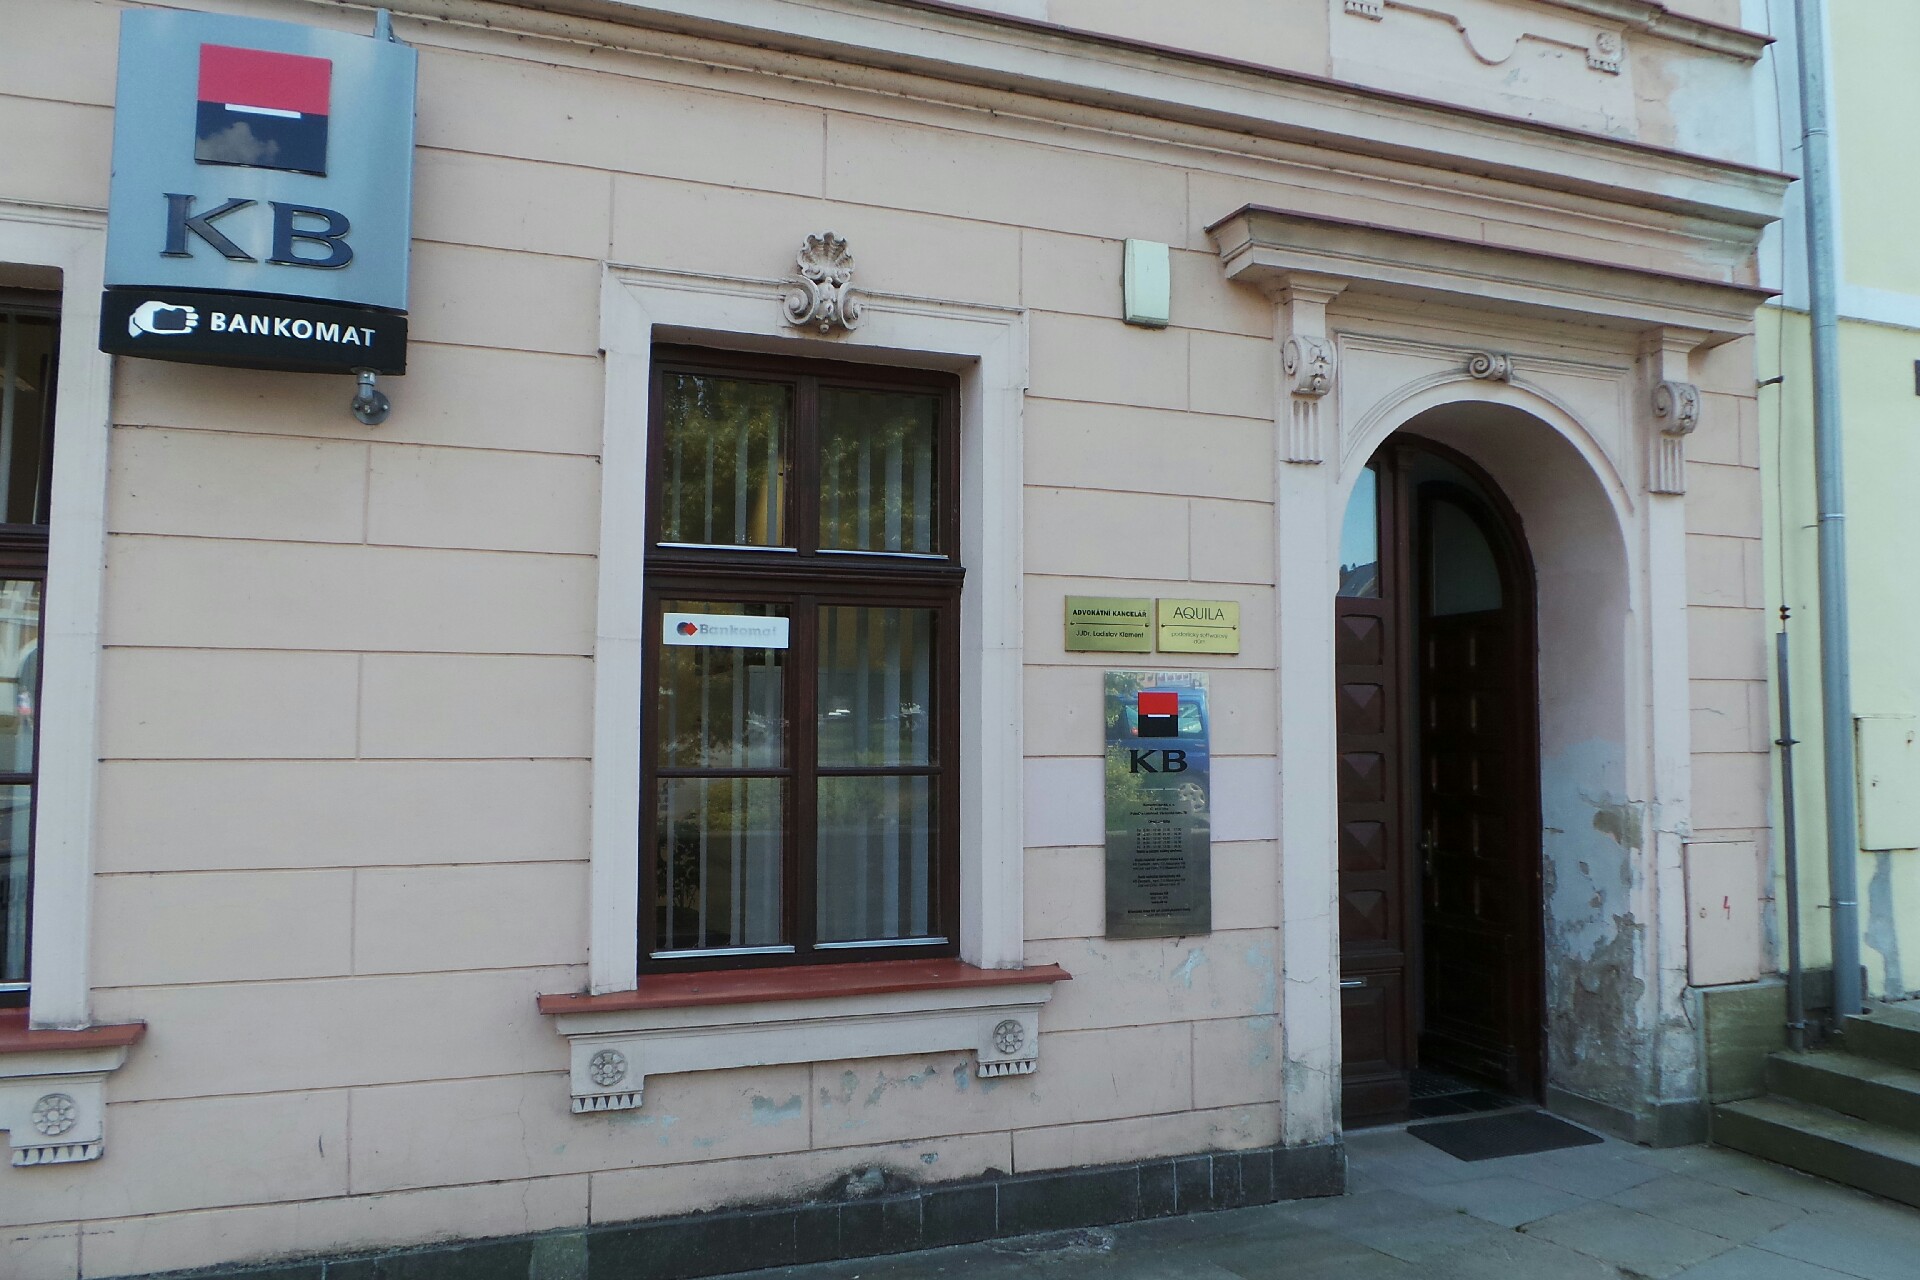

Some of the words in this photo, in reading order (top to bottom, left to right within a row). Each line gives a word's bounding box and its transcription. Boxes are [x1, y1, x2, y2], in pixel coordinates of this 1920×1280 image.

[159, 192, 355, 270] KB
[210, 310, 376, 348] BANKOMAT
[1072, 608, 1111, 617] ADVOKÁTNÍ
[1113, 609, 1147, 618] KANCELÁŘ
[1172, 606, 1225, 621] AQUILA
[699, 623, 778, 636] Bankomat
[1093, 630, 1118, 638] Ladislav
[1129, 749, 1188, 774] KB
